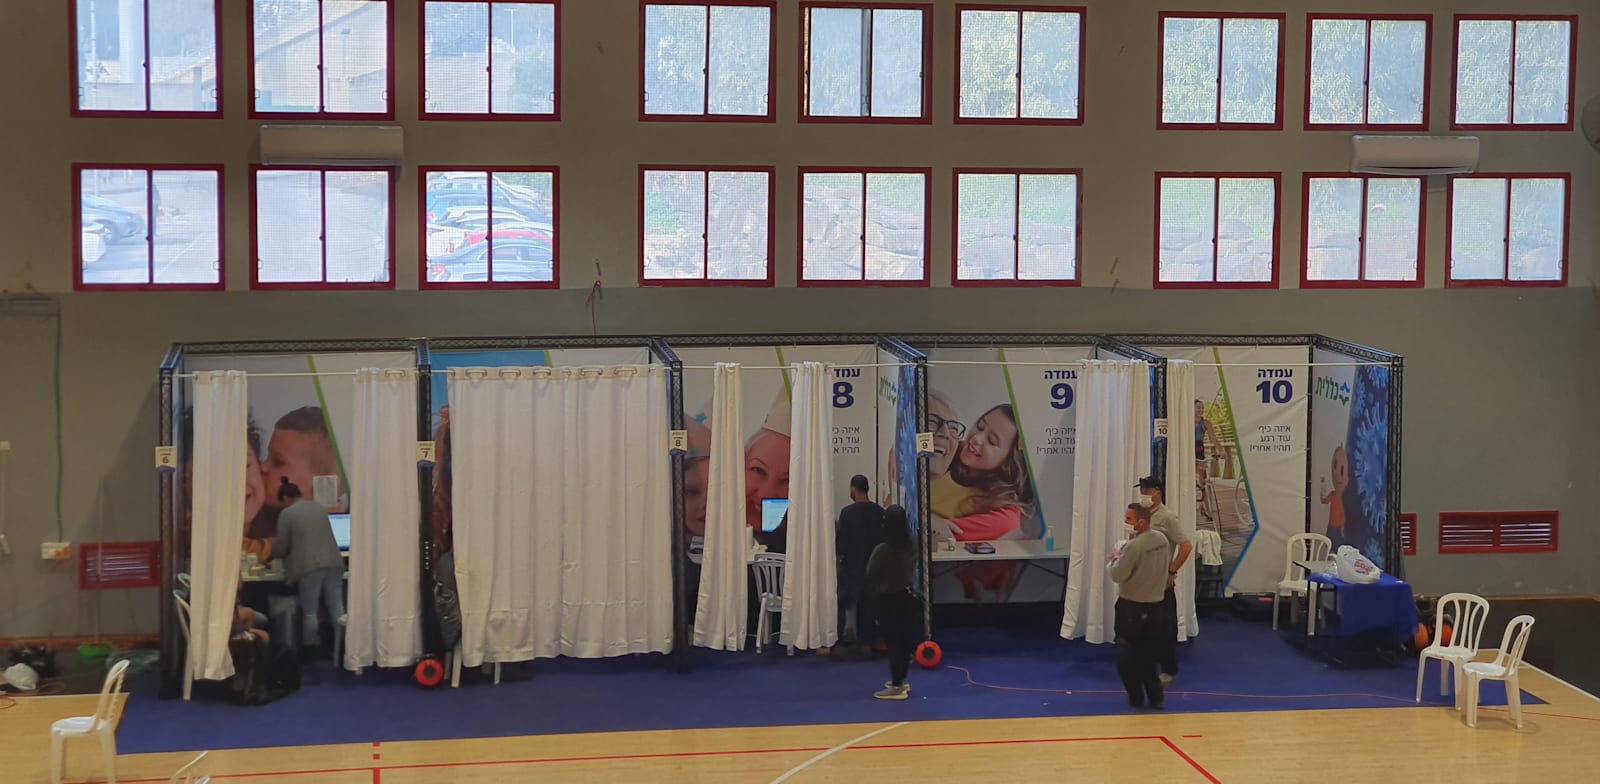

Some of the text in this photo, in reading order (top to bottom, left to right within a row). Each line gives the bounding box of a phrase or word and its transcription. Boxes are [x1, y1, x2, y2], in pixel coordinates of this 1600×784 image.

[833, 368, 860, 378] עמד
[1257, 368, 1293, 378] עמדה
[1256, 380, 1293, 404] 10
[1315, 375, 1339, 401] כללית
[832, 381, 855, 409] 8
[1050, 382, 1073, 410] 9
[842, 426, 860, 434] איזה
[1045, 427, 1059, 437] כיף
[1158, 427, 1168, 435] 10
[1258, 425, 1291, 434] איזה כיף
[675, 439, 681, 447] 8
[832, 436, 860, 444] עוד רג
[1260, 434, 1291, 443] עוד רגע
[922, 441, 928, 449] 9
[1273, 444, 1291, 452] תהיו
[422, 450, 429, 458] 7
[162, 455, 169, 464] 6
